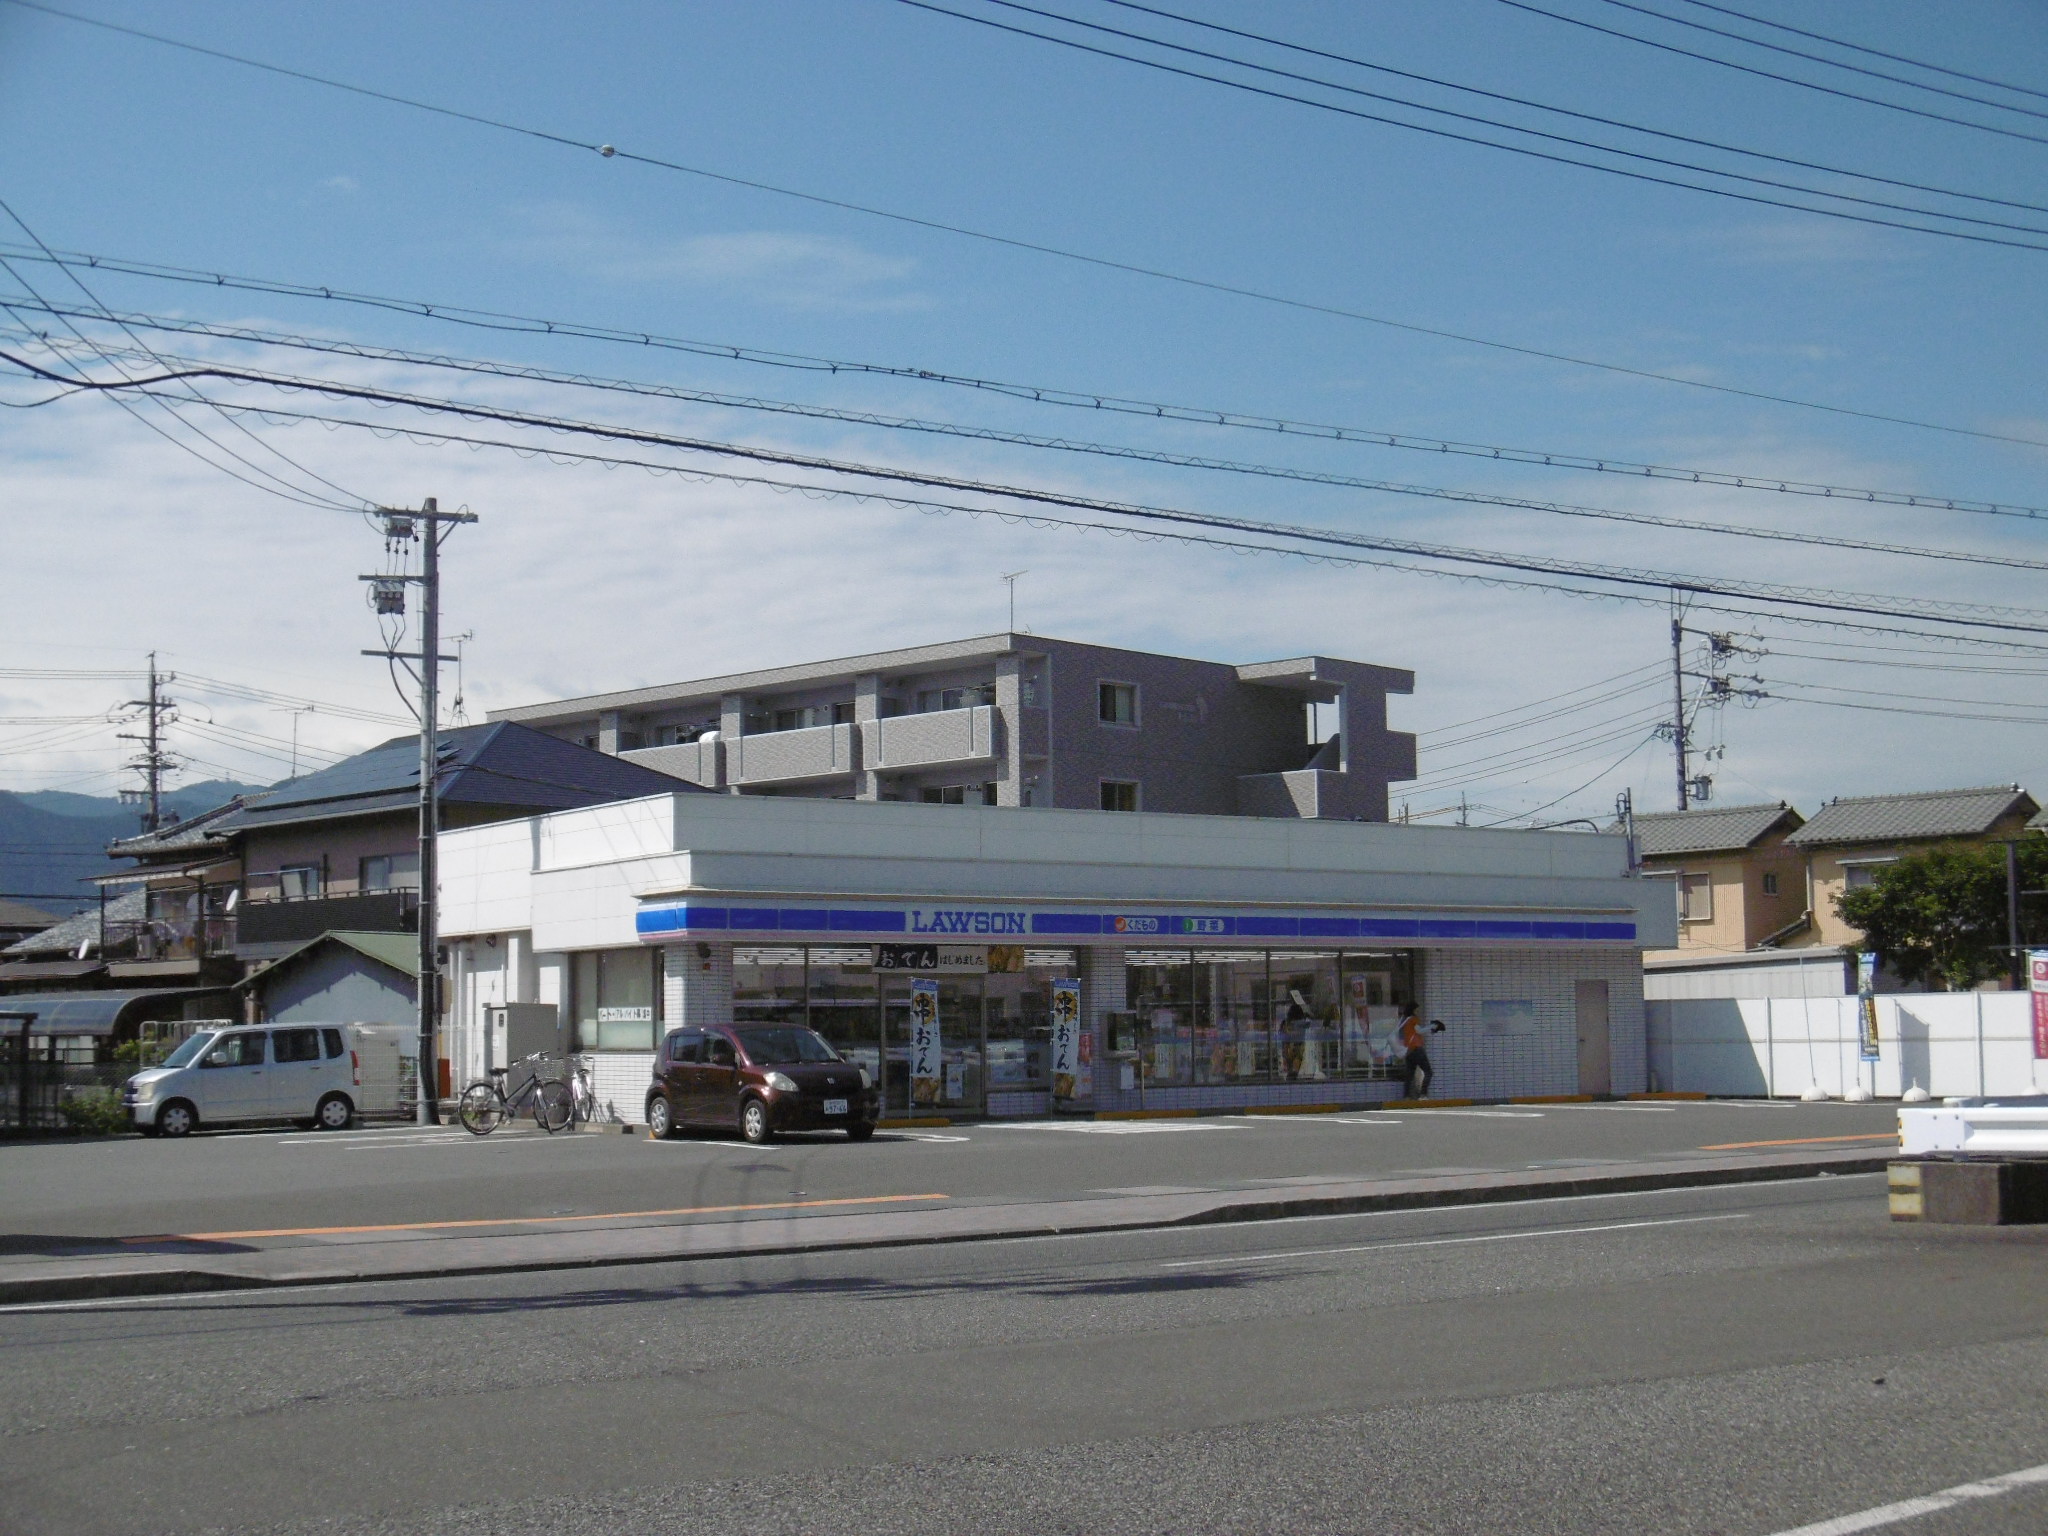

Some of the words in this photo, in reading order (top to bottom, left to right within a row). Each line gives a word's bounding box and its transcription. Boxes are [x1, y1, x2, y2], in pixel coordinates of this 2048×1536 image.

[912, 911, 1025, 933] LAWSON
[1127, 919, 1156, 932] くだもの
[1197, 919, 1219, 932] 野菜
[881, 950, 935, 968] おでん
[939, 954, 984, 967] はじめました
